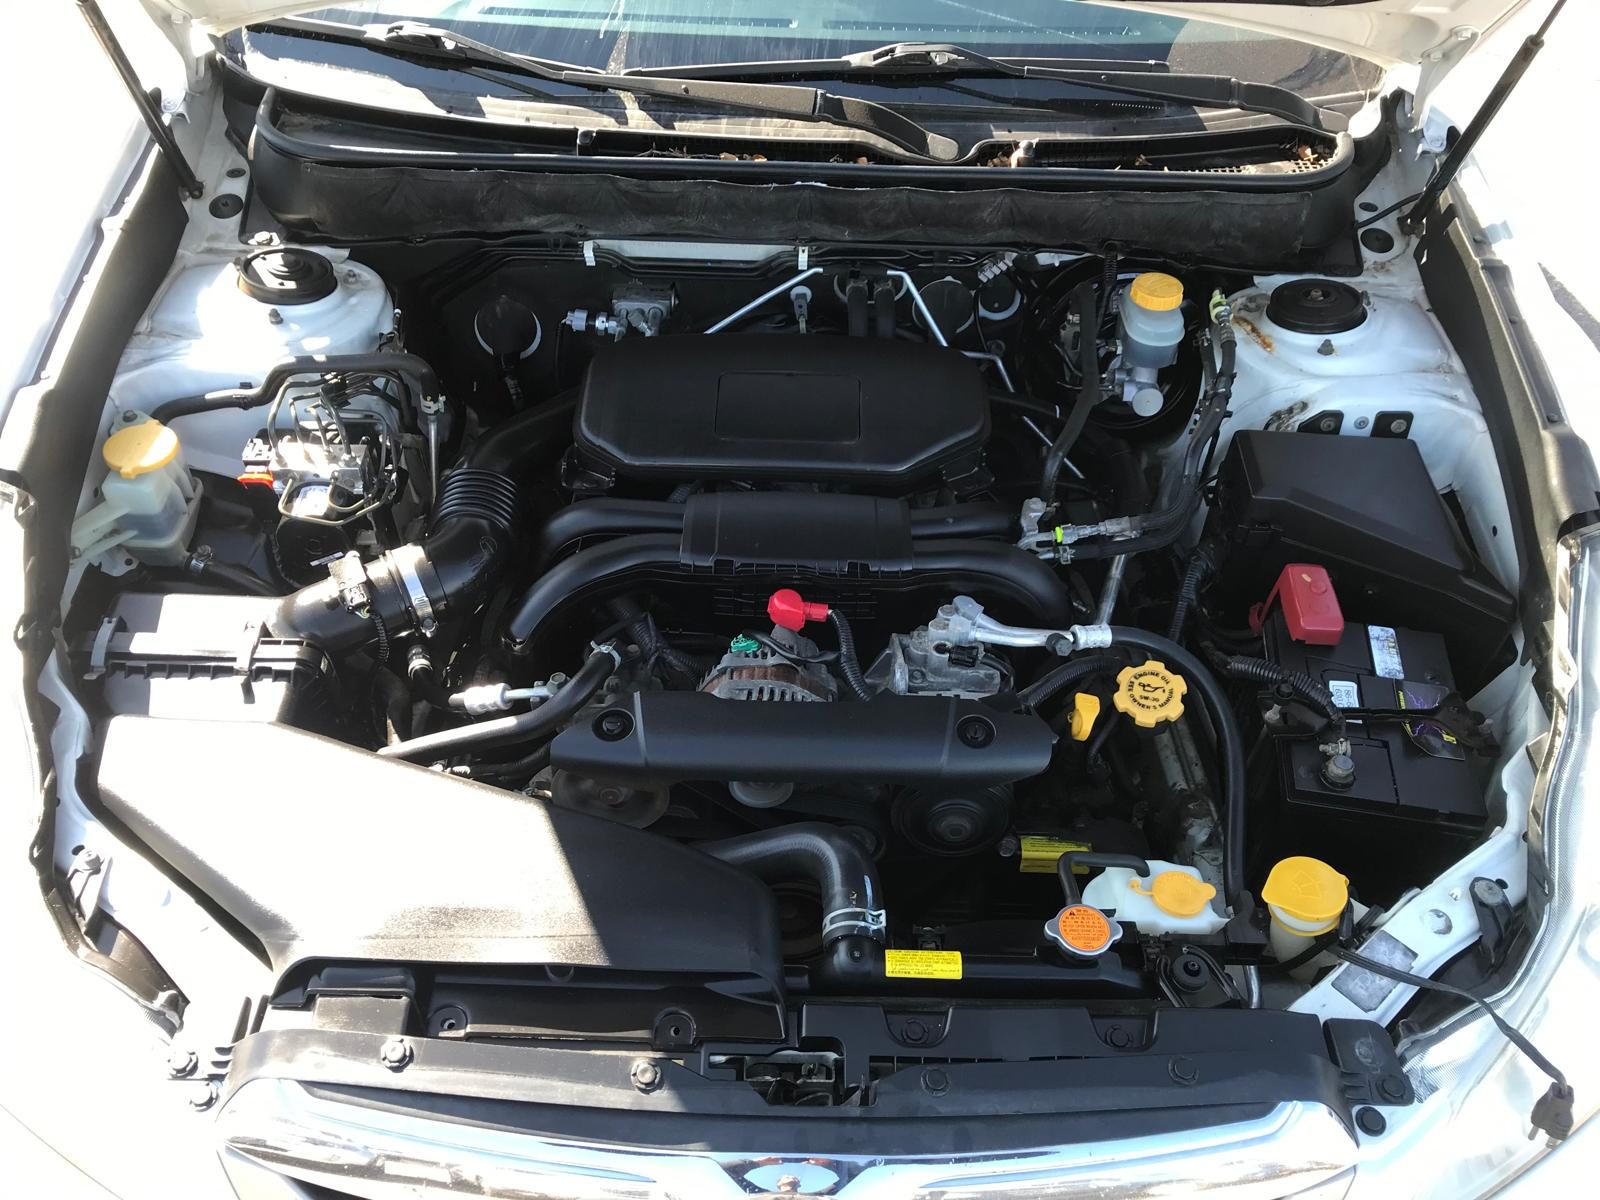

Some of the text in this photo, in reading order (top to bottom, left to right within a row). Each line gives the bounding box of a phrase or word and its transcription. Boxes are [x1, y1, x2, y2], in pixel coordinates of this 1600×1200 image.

[1134, 671, 1170, 685] ENGINE OIL
[1158, 688, 1174, 708] MANUAL
